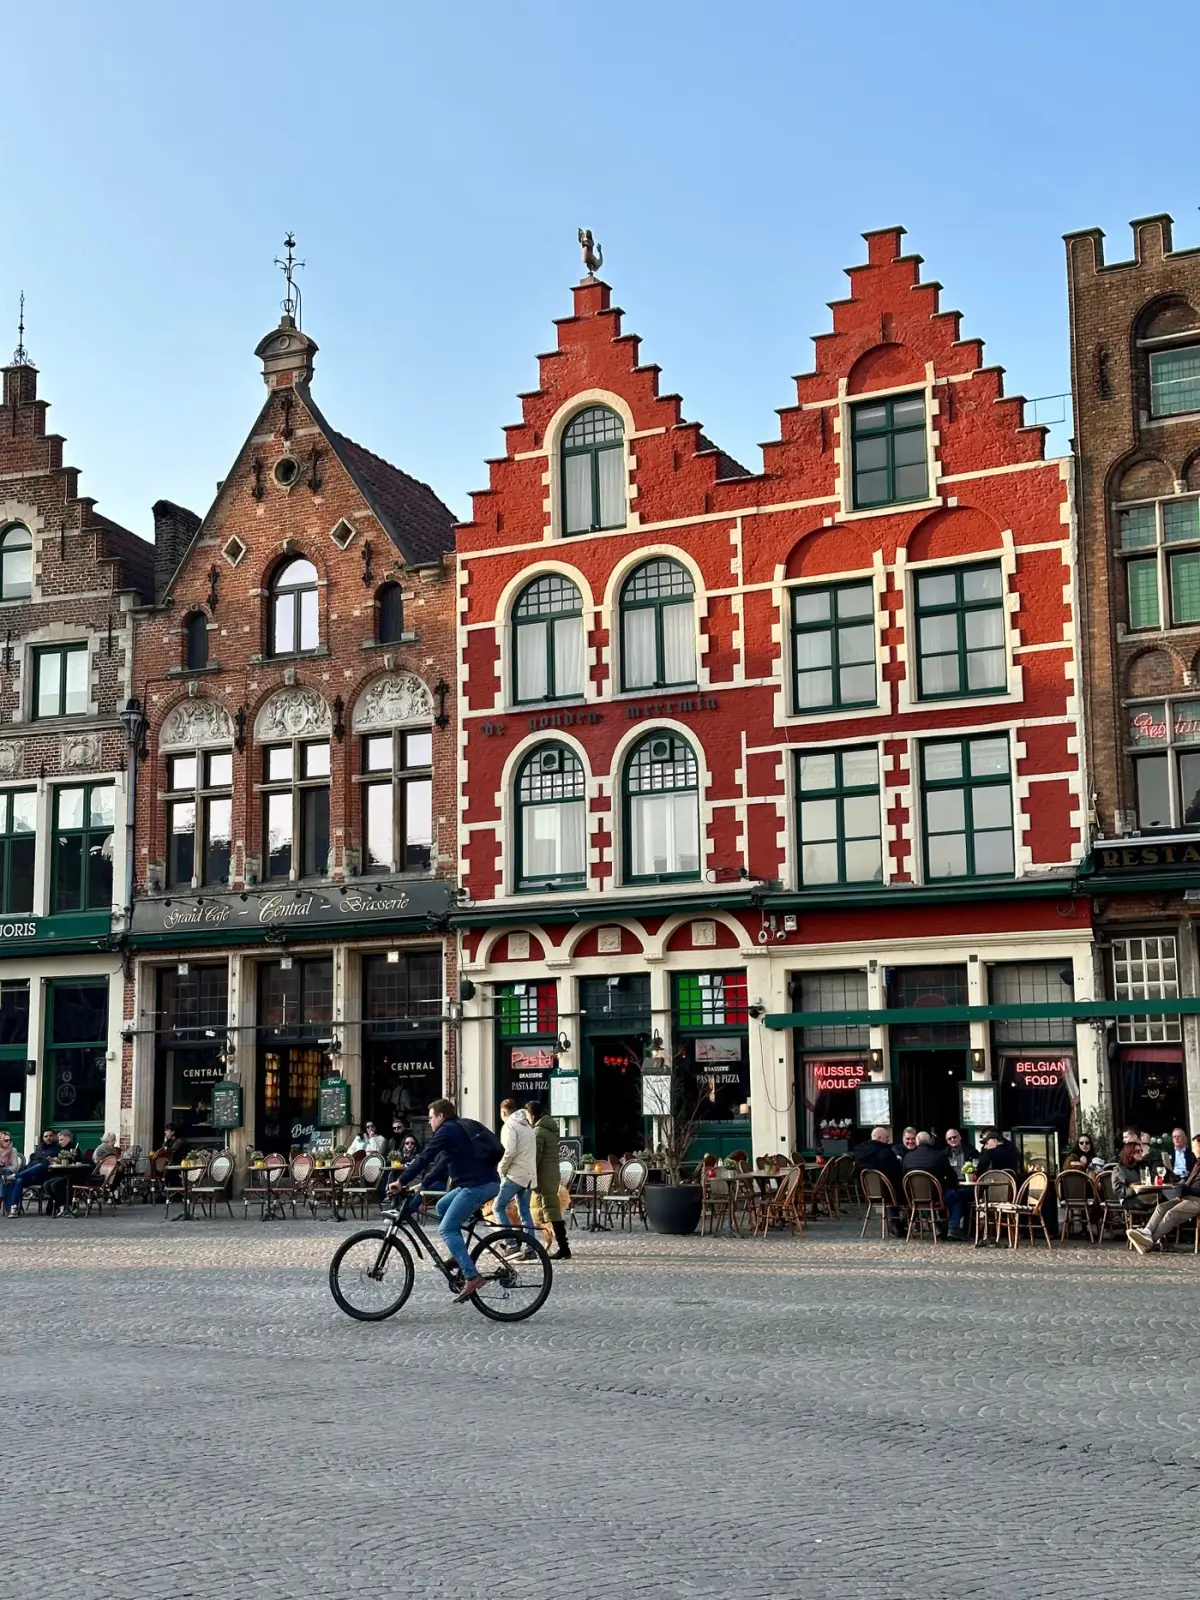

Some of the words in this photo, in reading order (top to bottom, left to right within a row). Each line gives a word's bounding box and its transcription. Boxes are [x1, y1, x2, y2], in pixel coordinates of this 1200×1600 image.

[163, 907, 203, 929] Grand
[258, 895, 314, 923] Central
[339, 894, 410, 913] Brasserie
[511, 1048, 552, 1069] Pasta
[391, 1061, 435, 1071] CENTRAL
[814, 1066, 864, 1077] MUSSELS
[1016, 1061, 1066, 1073] BELGIAN
[183, 1068, 223, 1077] CENTRAL
[721, 1073, 740, 1083] PIZZA
[511, 1082, 529, 1091] PASTA
[535, 1081, 549, 1090] PIZZ
[1025, 1075, 1058, 1086] FOOD
